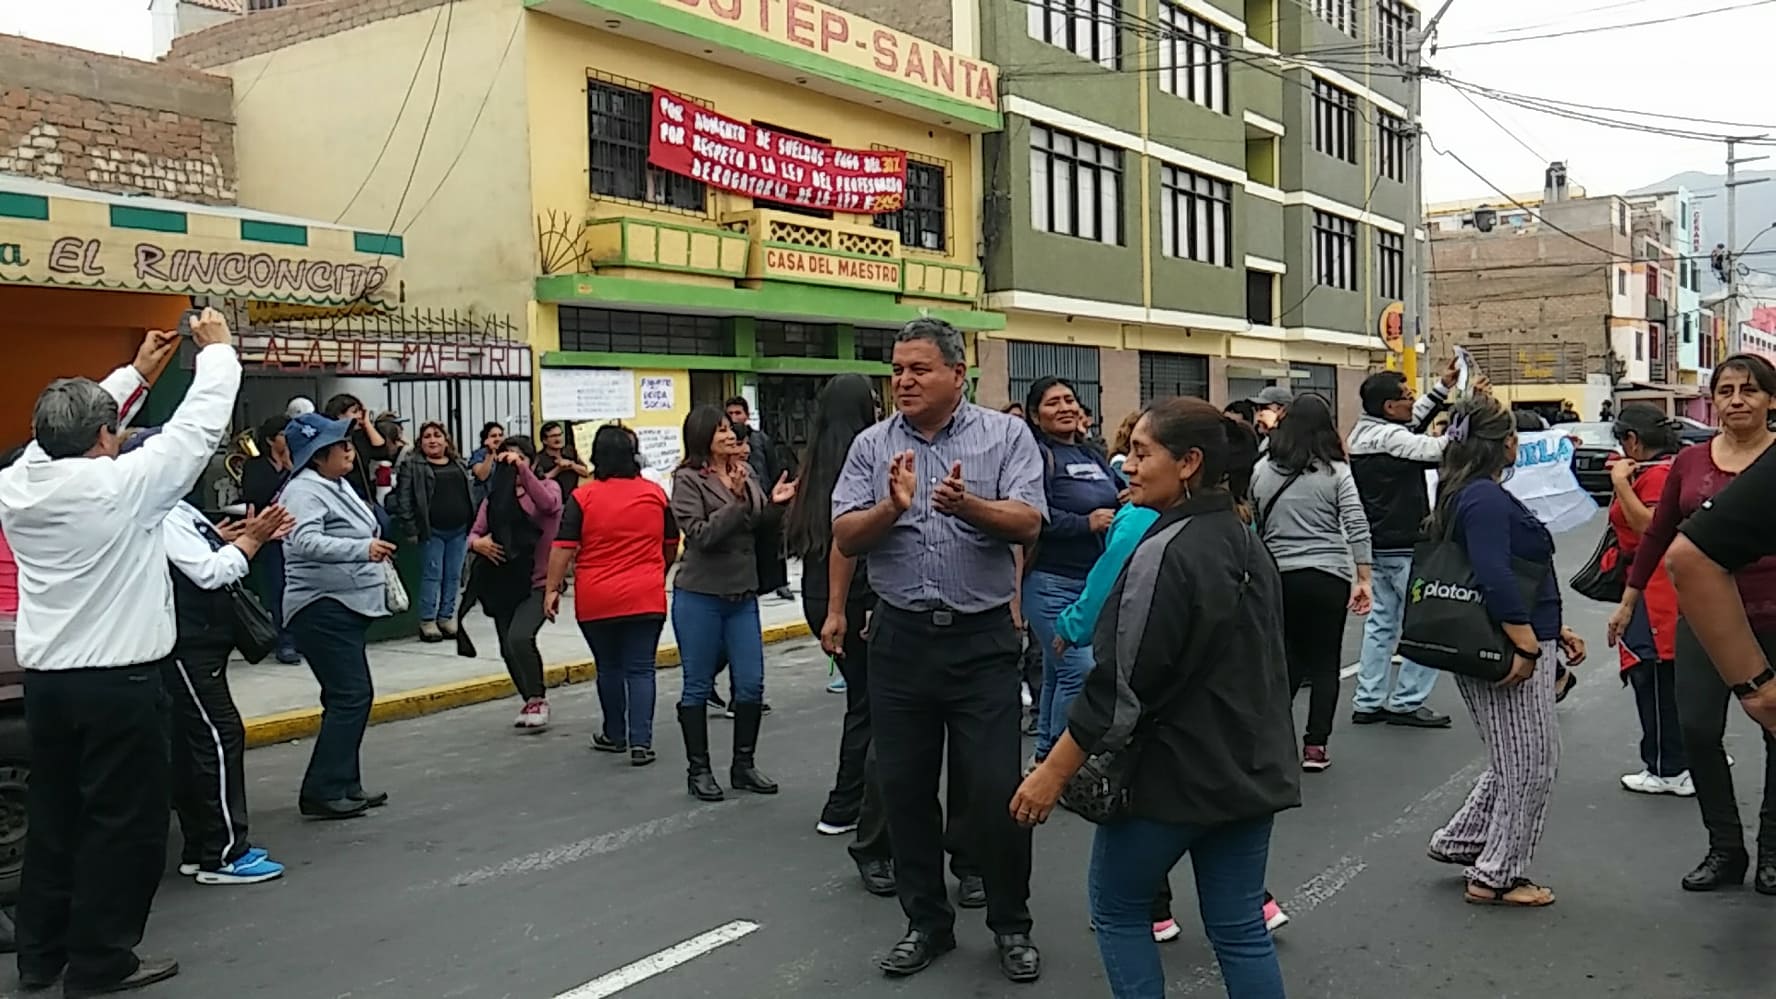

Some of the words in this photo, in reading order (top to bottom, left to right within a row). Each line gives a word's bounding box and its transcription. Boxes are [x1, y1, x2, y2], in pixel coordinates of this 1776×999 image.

[672, 0, 995, 104] TEP-SANTA
[660, 97, 684, 122] POR
[694, 112, 746, 143] AUMENTO
[756, 128, 771, 150] DE
[778, 138, 824, 167] SUELDOS
[660, 122, 685, 144] POR
[692, 134, 744, 168] RESPETO
[749, 153, 757, 170] A
[761, 156, 776, 175] LA
[781, 162, 804, 182] LEY
[812, 169, 833, 191] DEL
[49, 237, 104, 276] EL
[135, 243, 388, 297] RINCONCITO
[767, 250, 805, 272] CASA
[809, 255, 834, 275] DEL
[838, 259, 897, 283] MAESTRO
[402, 340, 522, 378] MAESTRO
